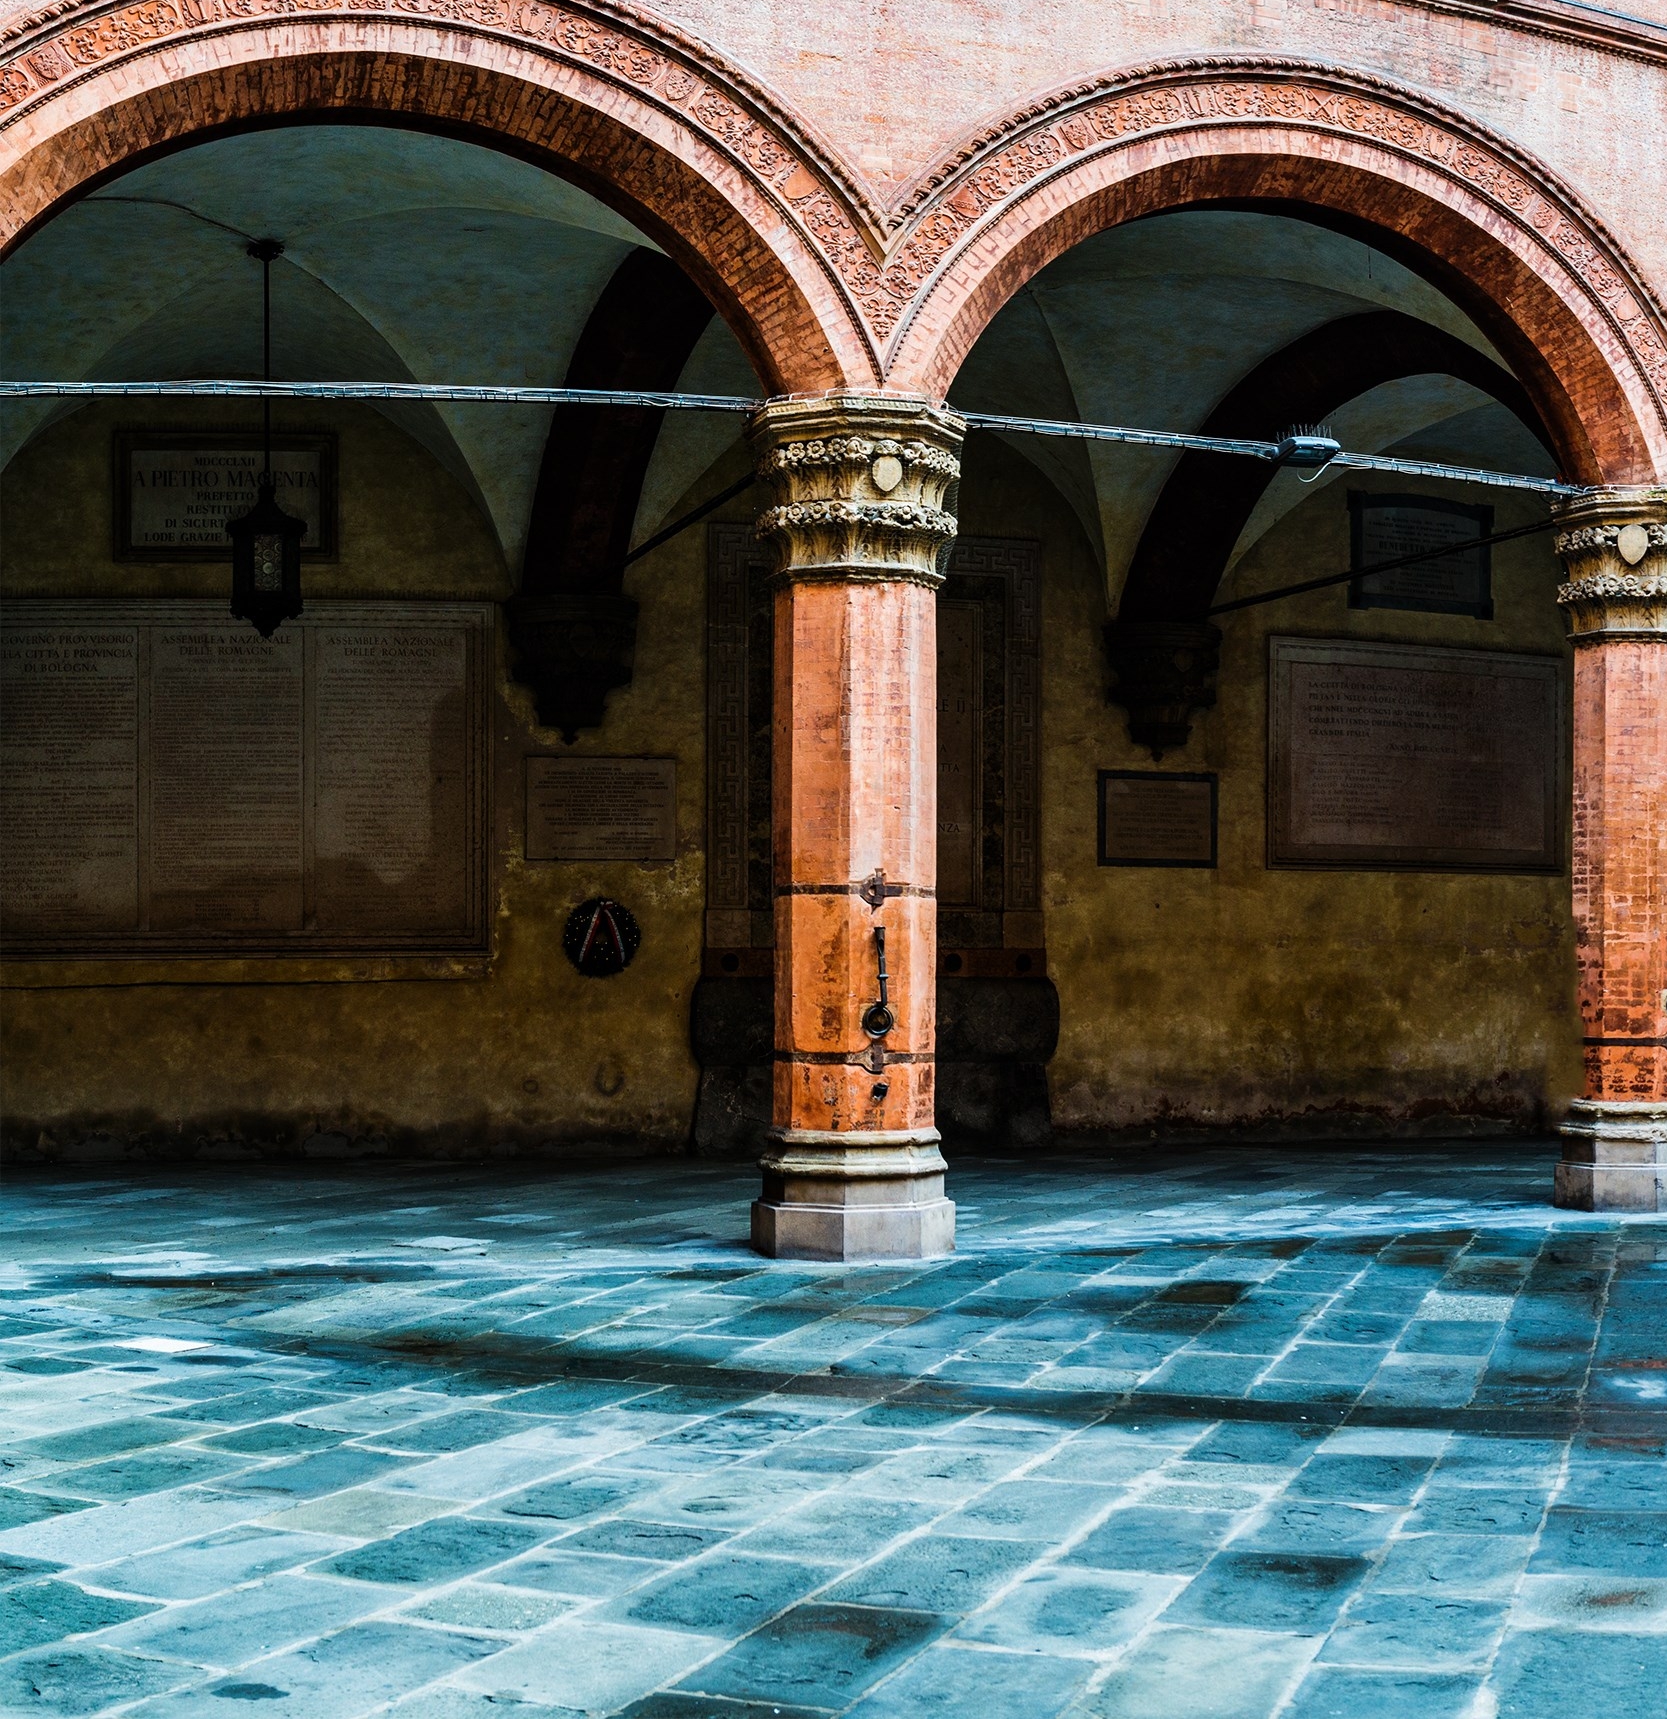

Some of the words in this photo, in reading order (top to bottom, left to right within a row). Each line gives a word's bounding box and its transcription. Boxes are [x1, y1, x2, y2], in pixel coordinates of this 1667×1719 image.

[133, 470, 146, 488] A
[151, 470, 219, 488] PIETRO
[196, 491, 254, 501] PREFETTO
[164, 519, 177, 529] DI
[182, 519, 225, 529] SICURT
[144, 532, 175, 542] LODE
[180, 533, 222, 542] GRAZIE
[0, 634, 55, 645] GOVERNO
[161, 634, 225, 644] ASSEMBLEA
[229, 634, 291, 644] NAZIONALE
[326, 636, 388, 646] ASSEMBLEA
[394, 637, 455, 647] NAZIONALE
[73, 649, 133, 658] PROVINCIA
[179, 646, 212, 656] DELLE
[218, 646, 274, 656] ROMAGNE
[344, 647, 375, 657] DELLE
[41, 663, 98, 673] BOLOGNA
